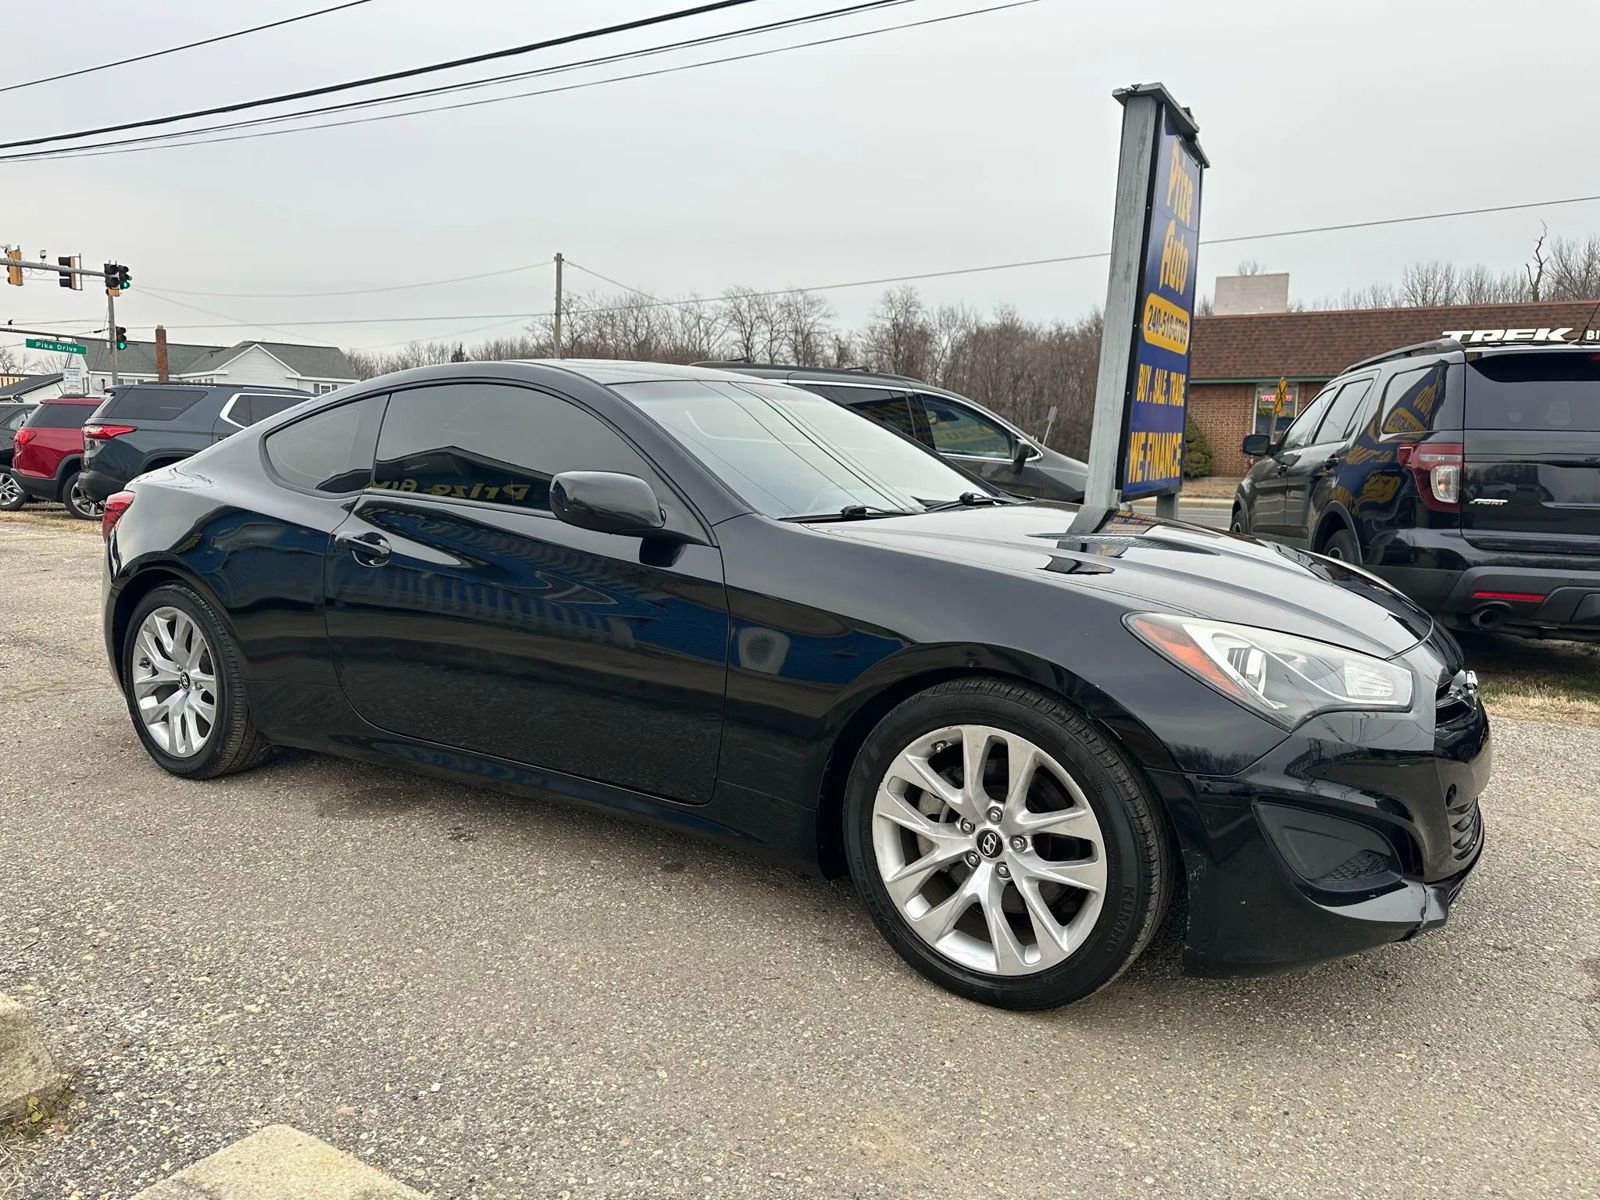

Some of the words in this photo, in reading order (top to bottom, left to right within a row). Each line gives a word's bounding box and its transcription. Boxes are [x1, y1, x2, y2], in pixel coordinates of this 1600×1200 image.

[1167, 137, 1194, 228] Prize
[1158, 218, 1189, 296] Auto
[56, 343, 77, 352] Drive
[1441, 327, 1574, 342] TREK
[1128, 432, 1147, 484] WE
[1144, 432, 1183, 481] FINANCE
